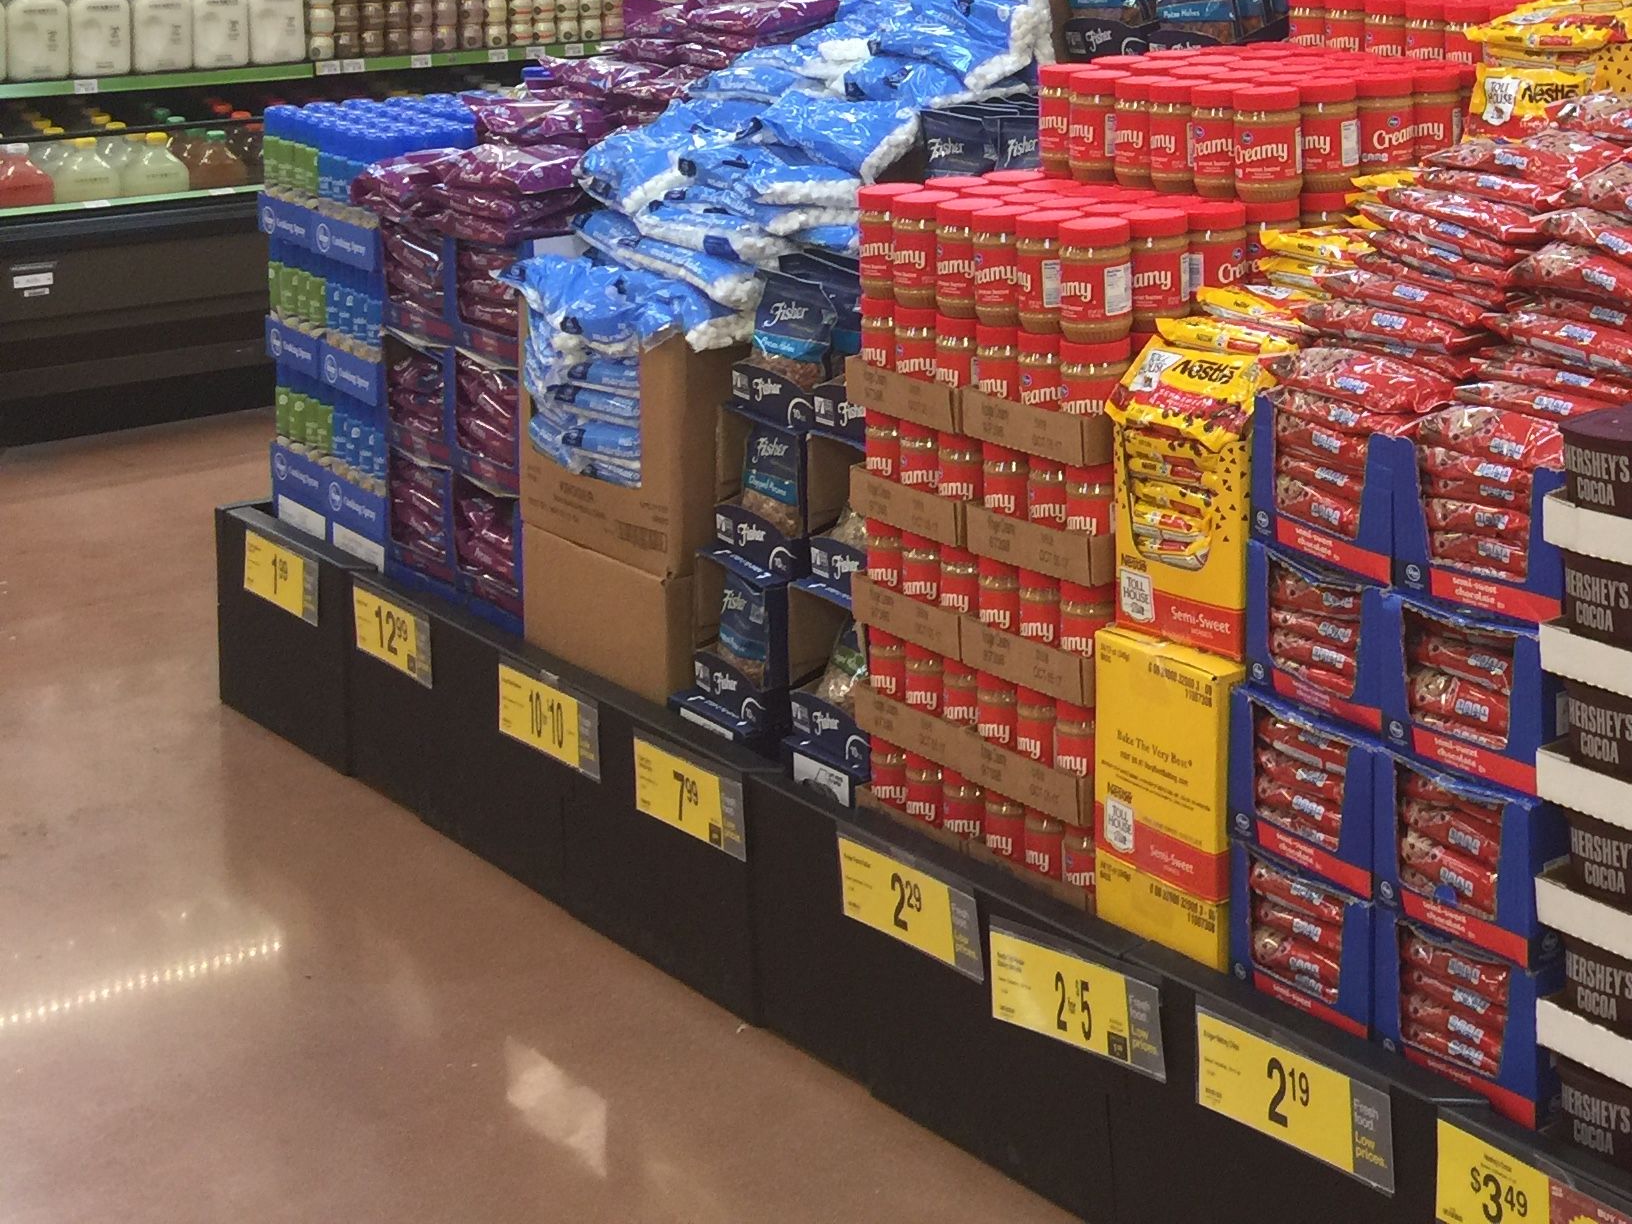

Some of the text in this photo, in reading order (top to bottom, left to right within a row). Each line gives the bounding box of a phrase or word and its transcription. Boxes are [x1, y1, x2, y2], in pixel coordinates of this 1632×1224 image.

[1085, 27, 1112, 53] Fisher
[1003, 136, 1038, 168] Fisher
[1195, 137, 1235, 158] reamy
[1234, 140, 1288, 165] Creamy
[1060, 280, 1093, 303] amy
[1131, 270, 1172, 291] amy
[763, 301, 809, 328] Fisher
[752, 378, 783, 402] Fisher
[751, 436, 790, 464] Fisher
[1566, 443, 1631, 483] HERSHEY'S
[1576, 477, 1616, 507] COCOA
[736, 522, 767, 547] Fisher
[831, 553, 860, 579] Fisher
[1122, 586, 1150, 606] HOUSE
[1126, 575, 1145, 593] TOLL
[1170, 604, 1232, 635] Semi-Sweet
[1575, 601, 1614, 633] COCOA
[712, 671, 738, 695] Fisher
[811, 711, 840, 736] Fisher
[1135, 735, 1151, 753] The
[1152, 741, 1169, 764] Very
[1580, 731, 1619, 765] COCOA
[1107, 815, 1132, 835] HOUSE
[1584, 862, 1627, 895] COCOA
[1576, 984, 1618, 1022] COCOA
[1561, 1080, 1632, 1135] HERSHEY'S
[1572, 1118, 1615, 1157] COCOA
